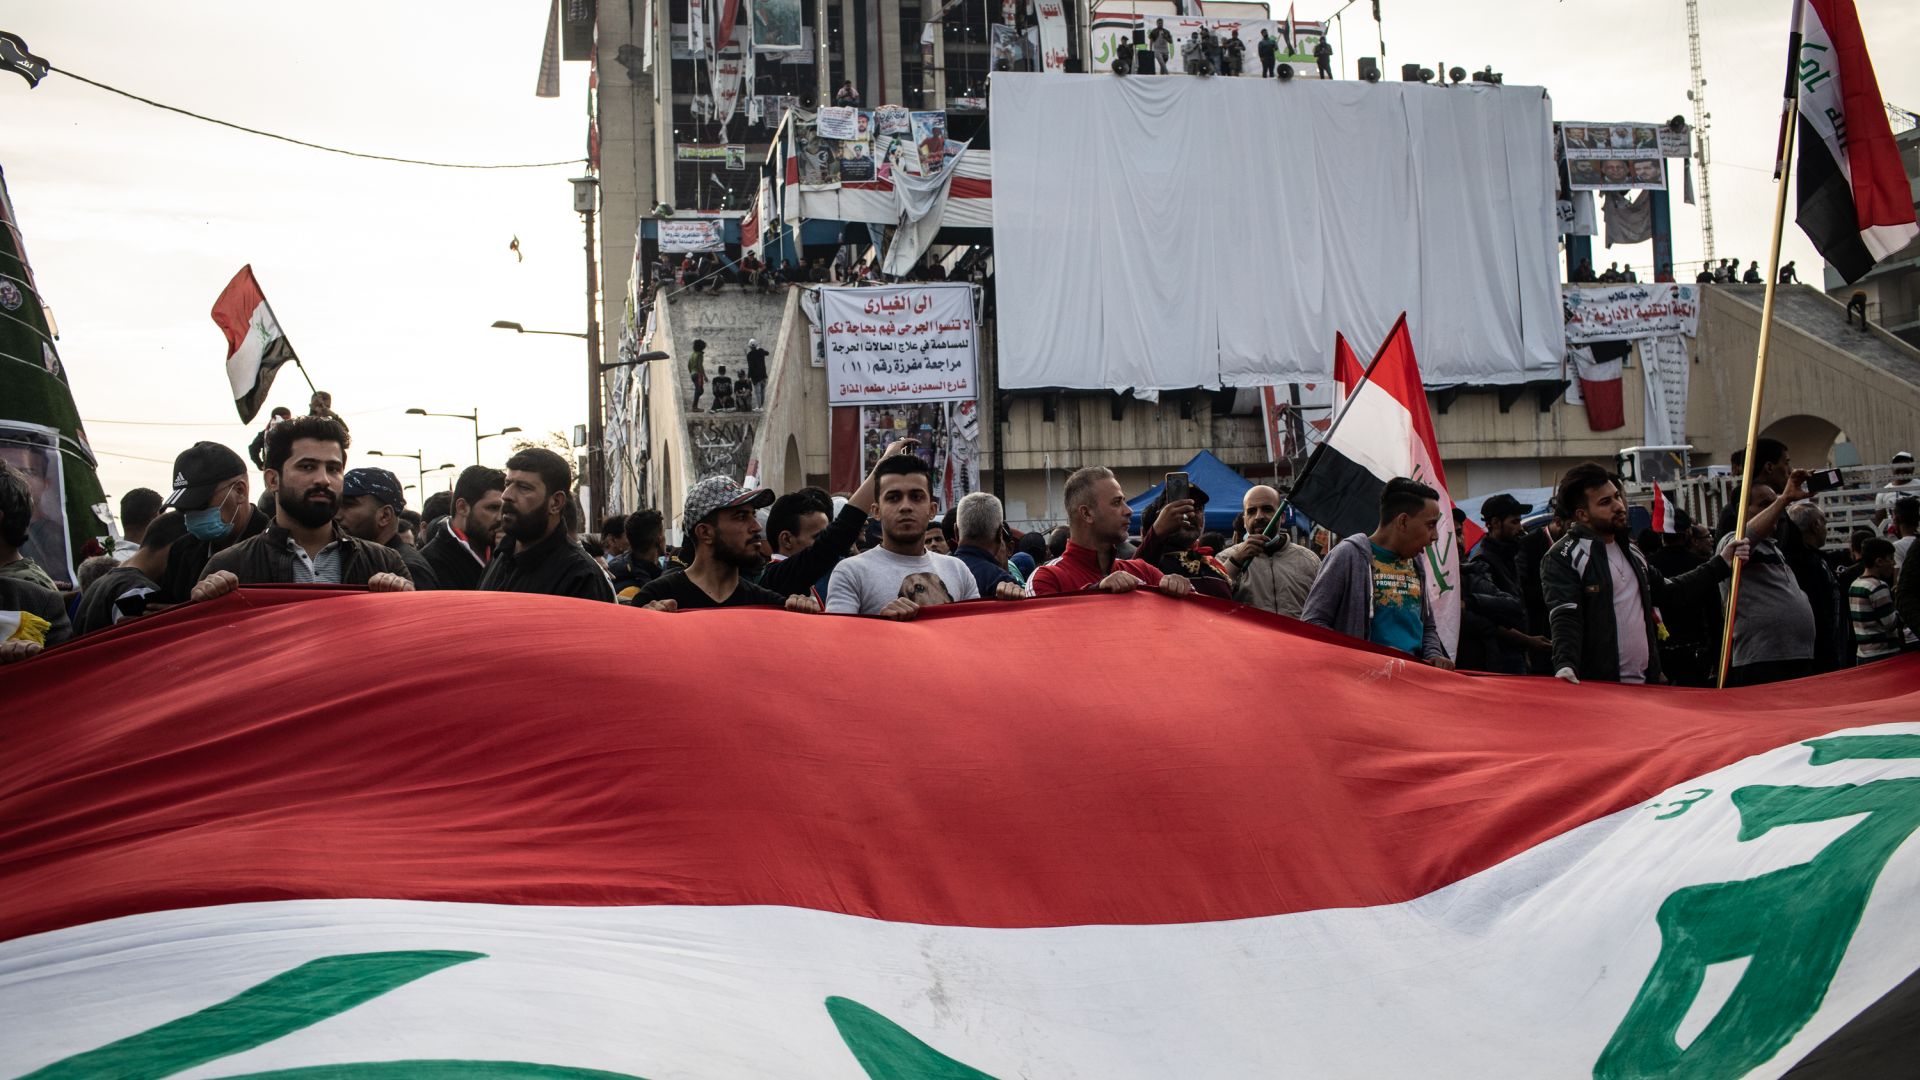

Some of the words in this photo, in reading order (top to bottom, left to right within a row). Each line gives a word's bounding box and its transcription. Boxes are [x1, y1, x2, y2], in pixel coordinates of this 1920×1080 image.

[914, 295, 932, 314] الى
[827, 323, 844, 336] لكم
[846, 321, 876, 337] بحاجة
[879, 320, 896, 336] فهم
[898, 321, 933, 336] الجرحى
[936, 319, 961, 333] تنسوا
[963, 319, 971, 330] لا
[832, 341, 863, 353] الحرجة
[865, 341, 897, 351] الحالات
[898, 341, 918, 353] علاج
[919, 339, 930, 355] في
[931, 339, 969, 350] للمساهمة
[872, 359, 893, 375] رقم
[894, 358, 923, 375] مفرزة
[925, 357, 962, 373] مراجعة
[840, 384, 862, 397] المذاق
[863, 383, 885, 396] مطعم
[887, 382, 910, 395] مقابل
[912, 382, 946, 395] السعدون
[947, 378, 967, 391] شارع
